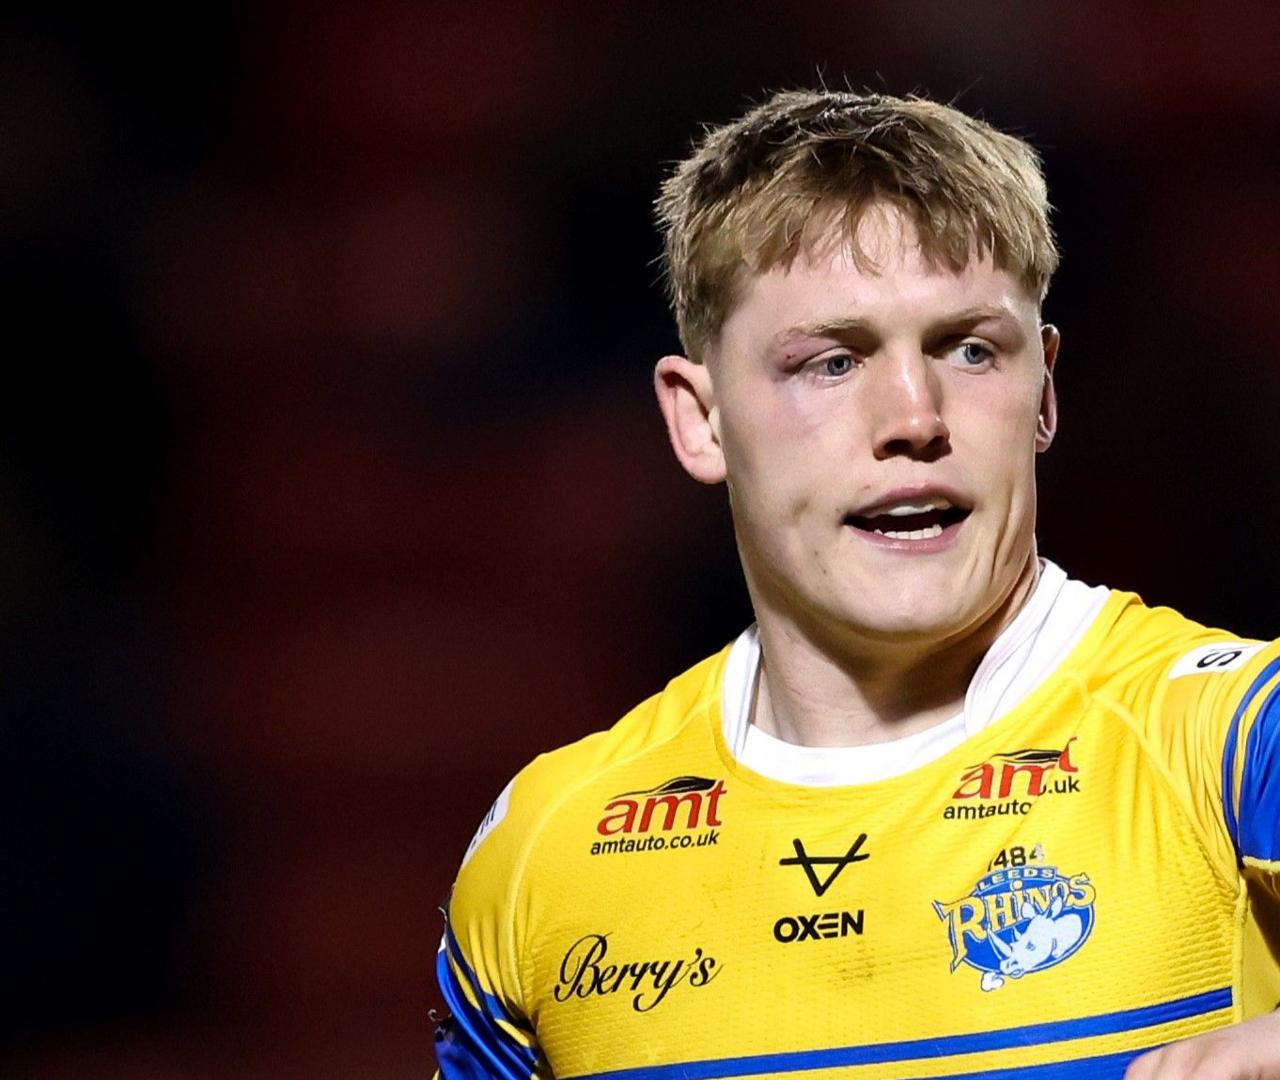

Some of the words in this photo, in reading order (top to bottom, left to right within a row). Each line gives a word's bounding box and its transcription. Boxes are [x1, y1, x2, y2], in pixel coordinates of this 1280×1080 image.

[597, 780, 727, 836] amt
[590, 830, 720, 856] amtauto.co.uk
[977, 868, 1057, 891] LEEDS
[773, 909, 865, 944] OXEN
[554, 930, 725, 1013] Berry's
